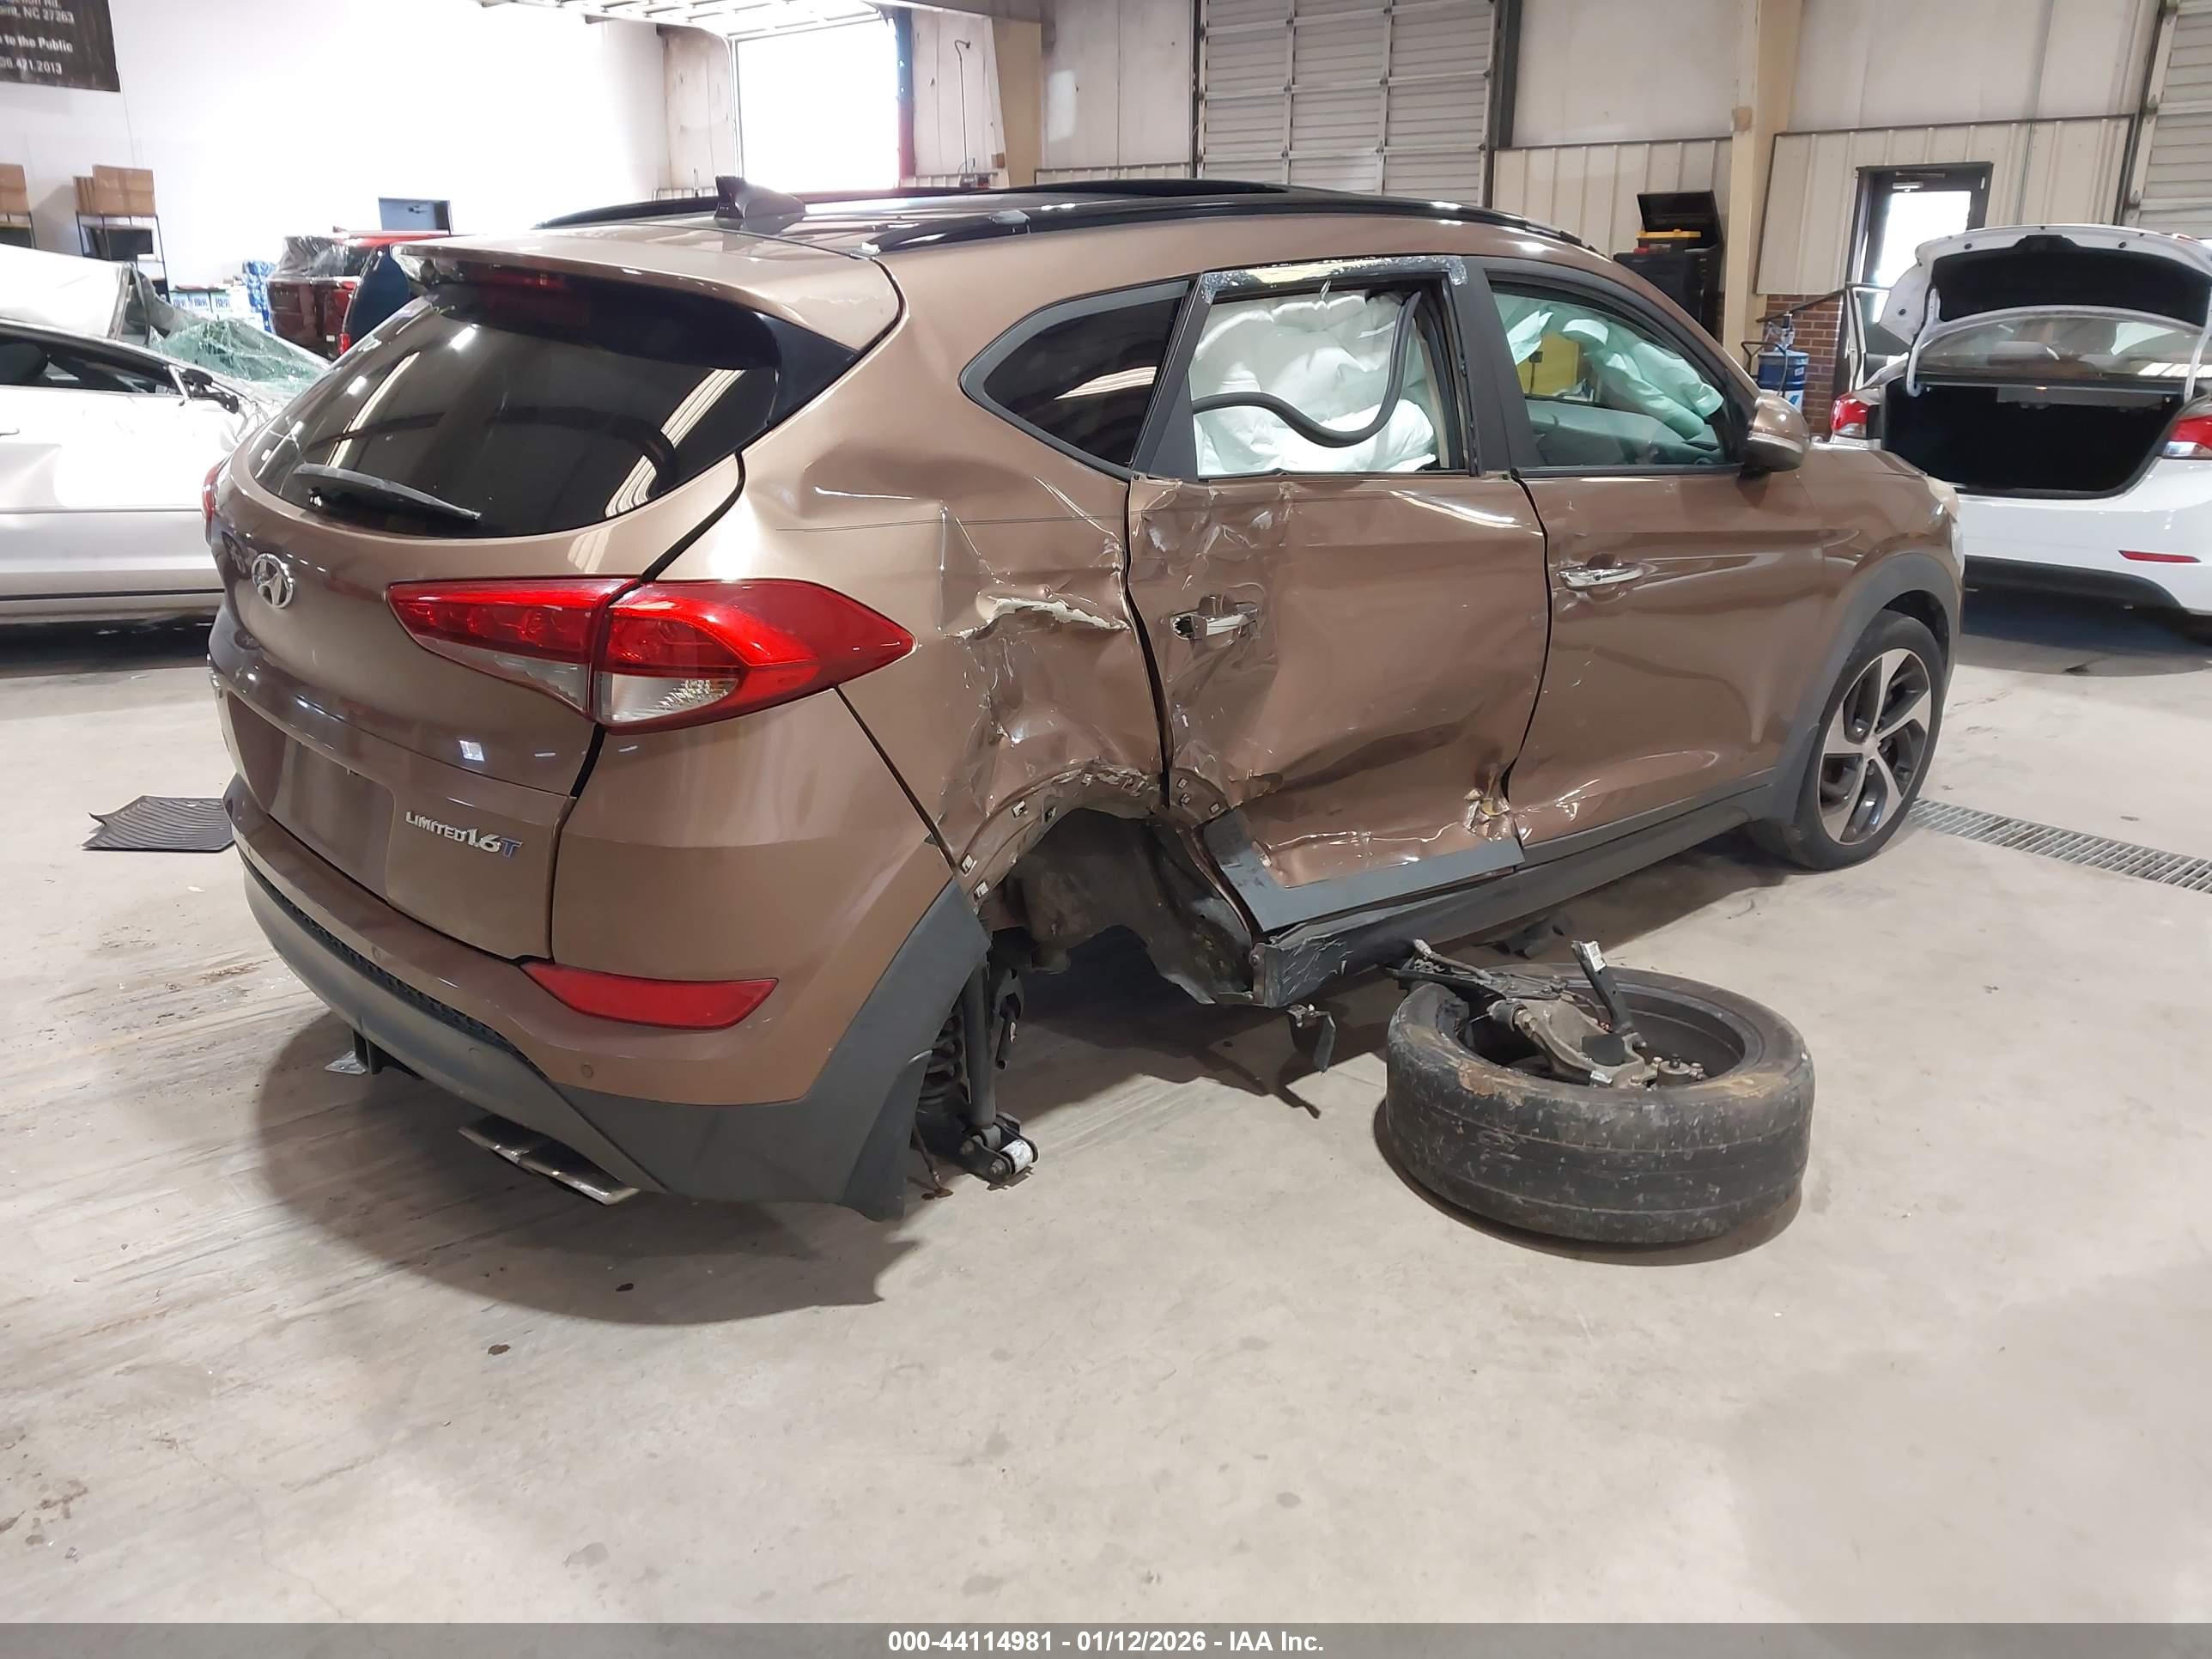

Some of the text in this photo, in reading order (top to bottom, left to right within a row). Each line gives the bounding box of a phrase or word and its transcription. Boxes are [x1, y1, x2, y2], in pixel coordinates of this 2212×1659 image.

[23, 6, 40, 20] NC
[4, 34, 15, 46] to
[17, 34, 35, 48] the
[37, 36, 73, 52] Public
[405, 811, 467, 842] LIMITED
